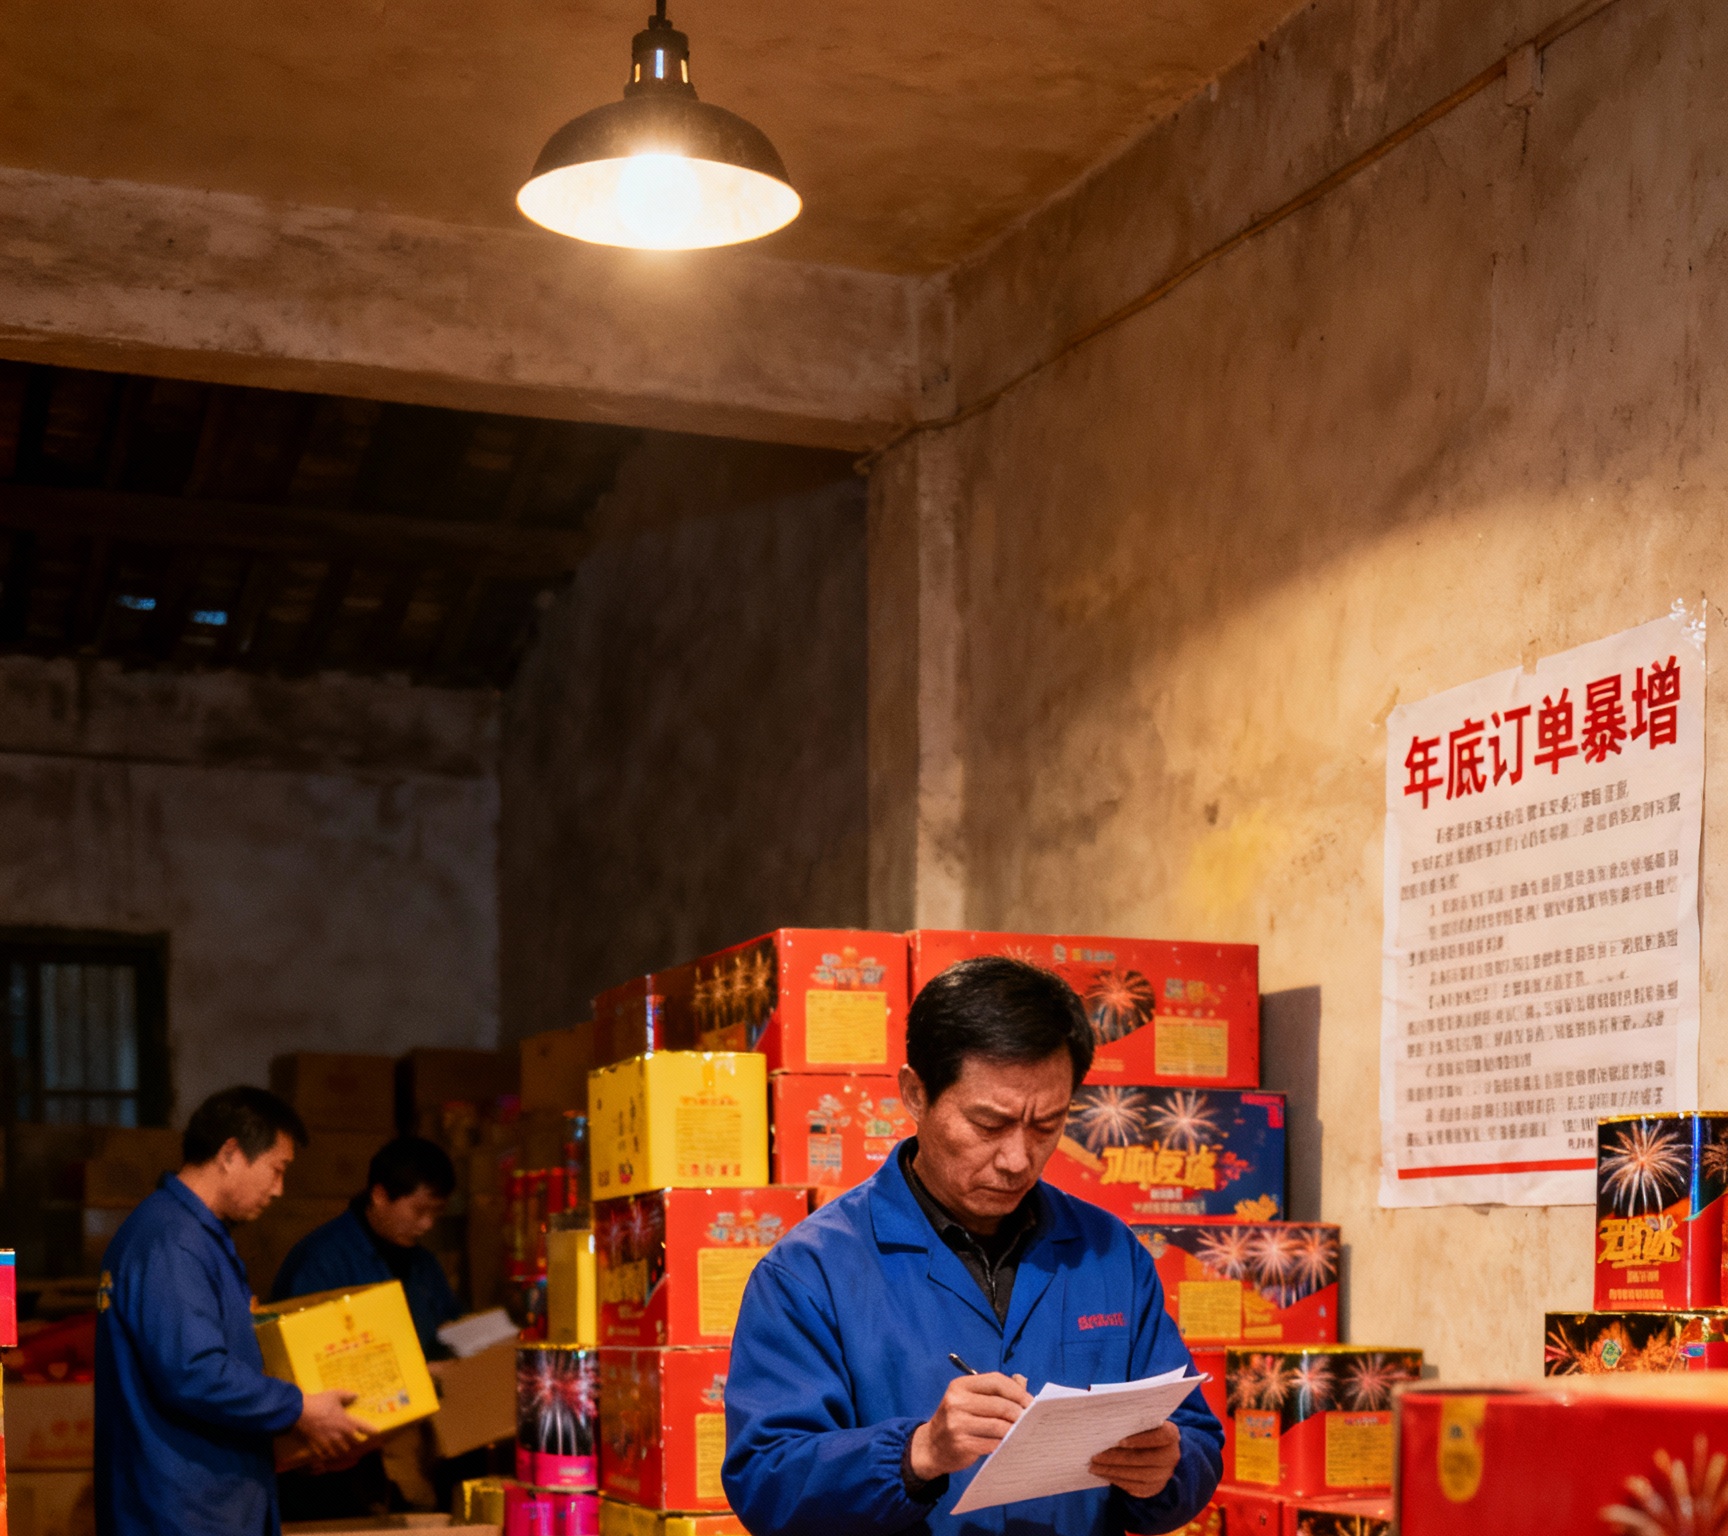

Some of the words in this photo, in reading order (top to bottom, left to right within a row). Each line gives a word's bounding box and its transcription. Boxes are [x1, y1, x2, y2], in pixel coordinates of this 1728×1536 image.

[1404, 655, 1681, 809] 年底订单暴增
